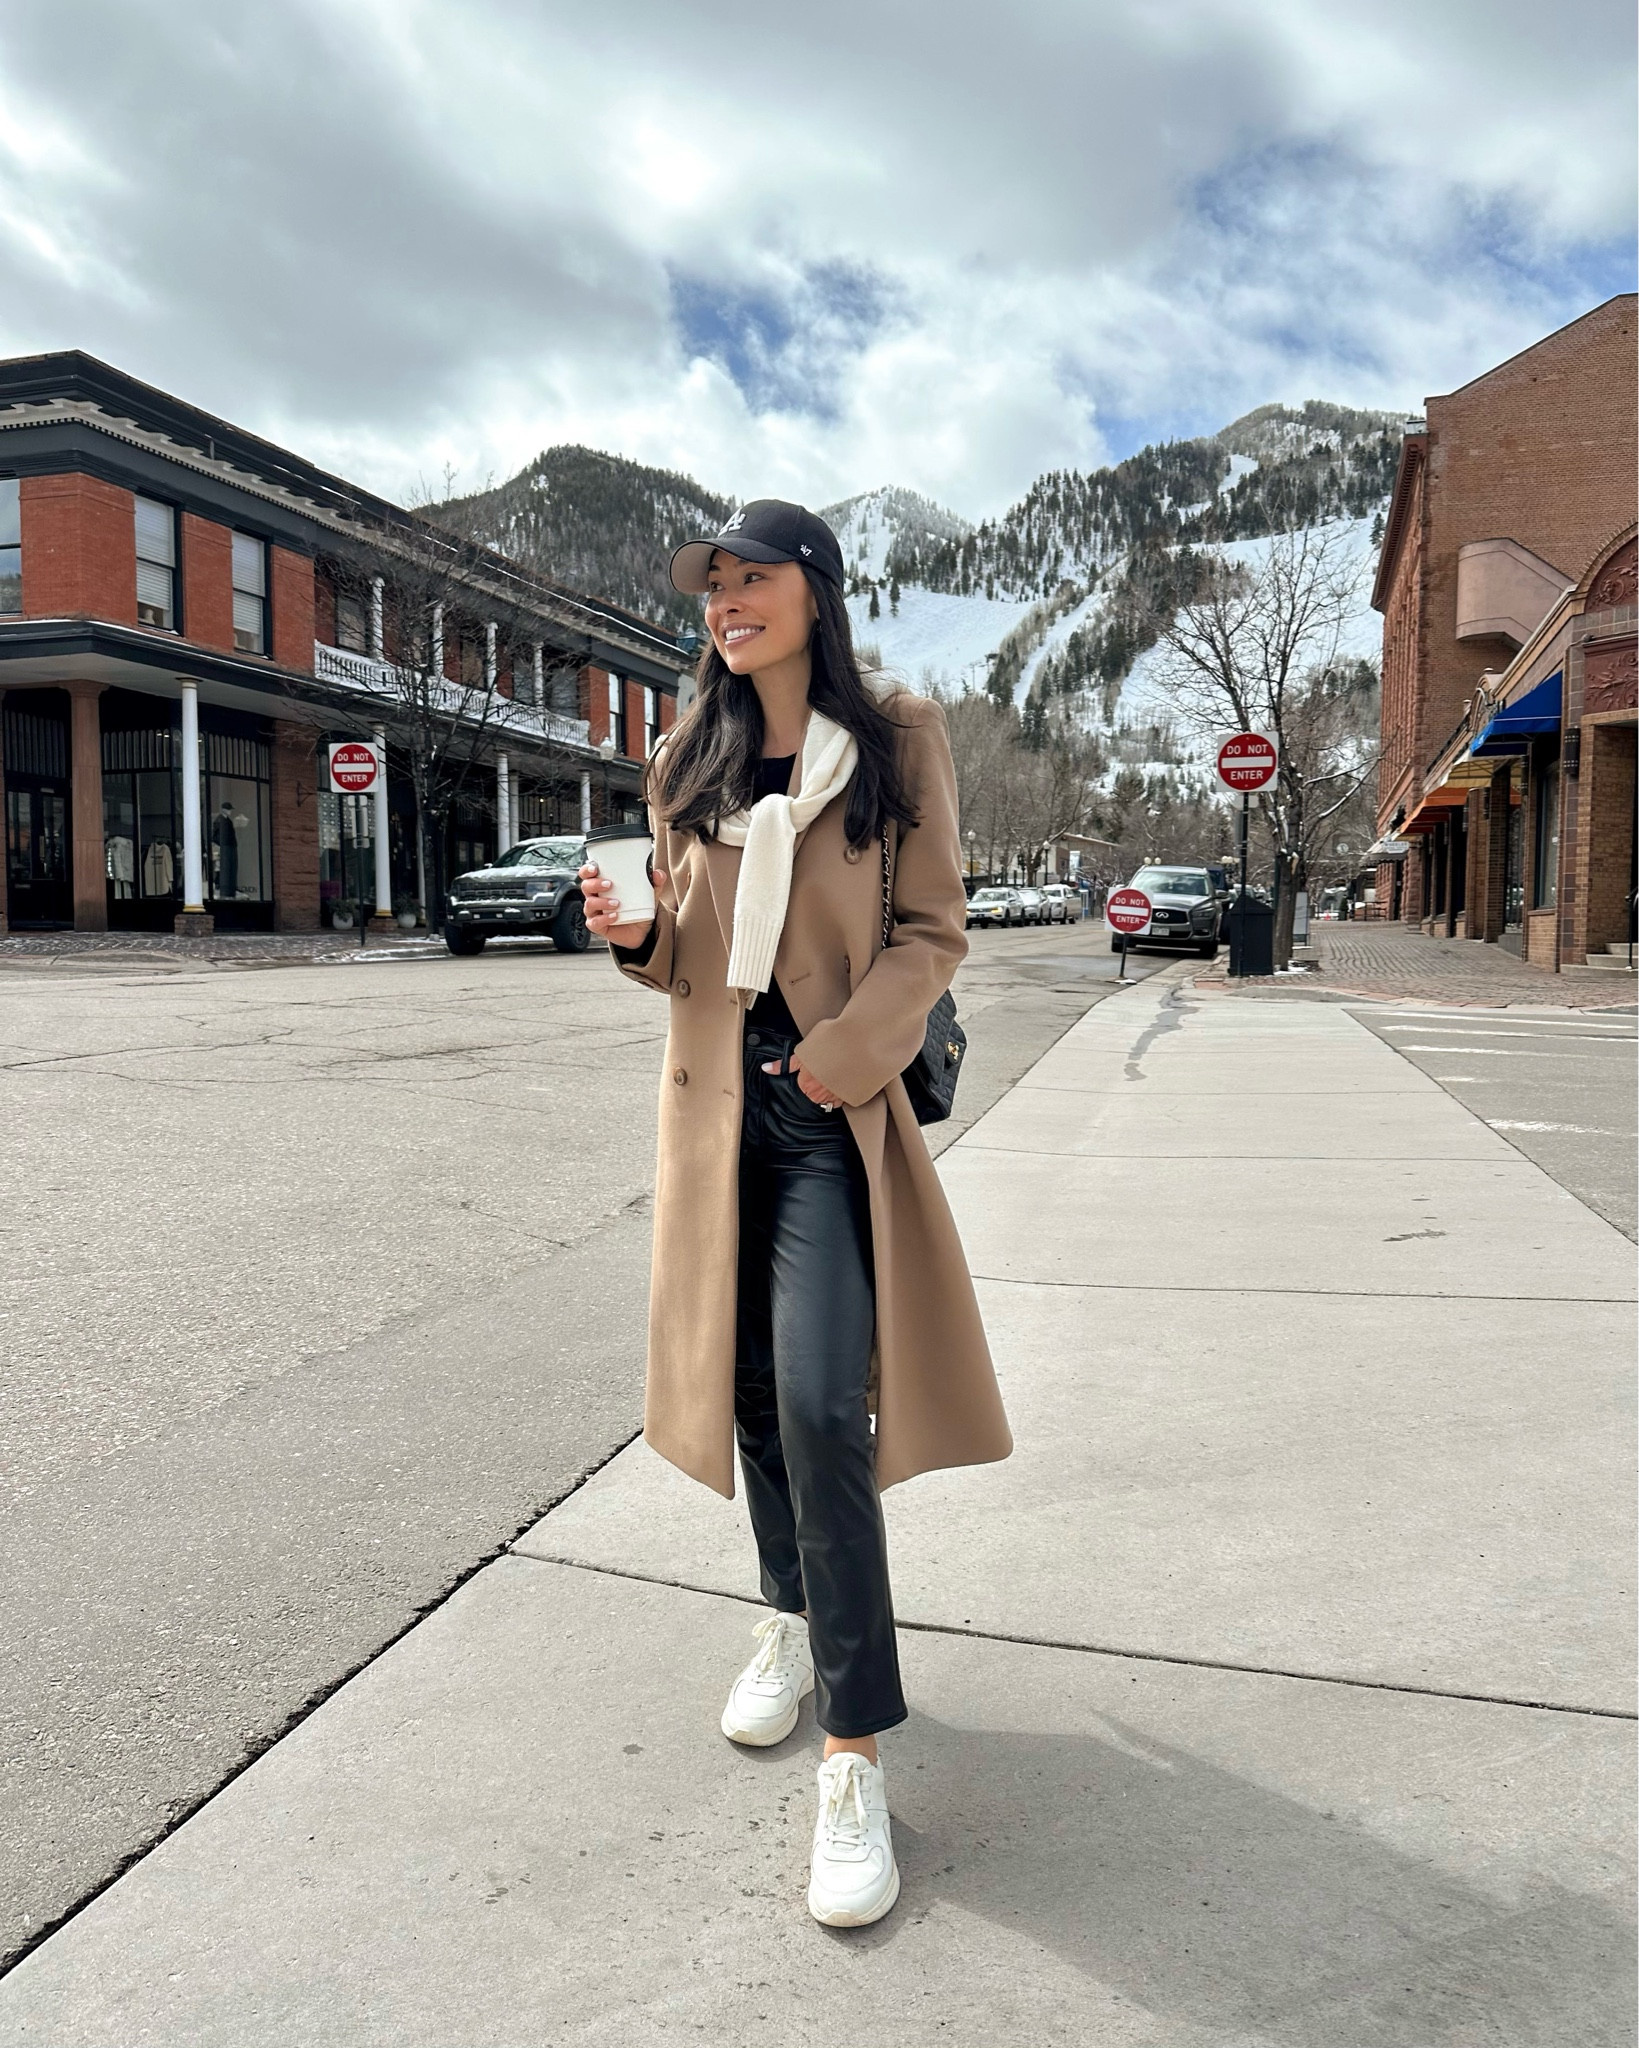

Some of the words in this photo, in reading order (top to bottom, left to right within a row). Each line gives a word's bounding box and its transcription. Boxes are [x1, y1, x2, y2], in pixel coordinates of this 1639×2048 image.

[1226, 745, 1241, 755] DO
[1247, 743, 1268, 754] NOT
[337, 753, 349, 762] DO
[353, 753, 370, 762] NOT
[341, 774, 368, 783] ENTER
[1230, 770, 1264, 780] ENTER
[1115, 896, 1126, 904] DO
[1129, 897, 1146, 906] NOT
[1116, 915, 1141, 924] ENTER
